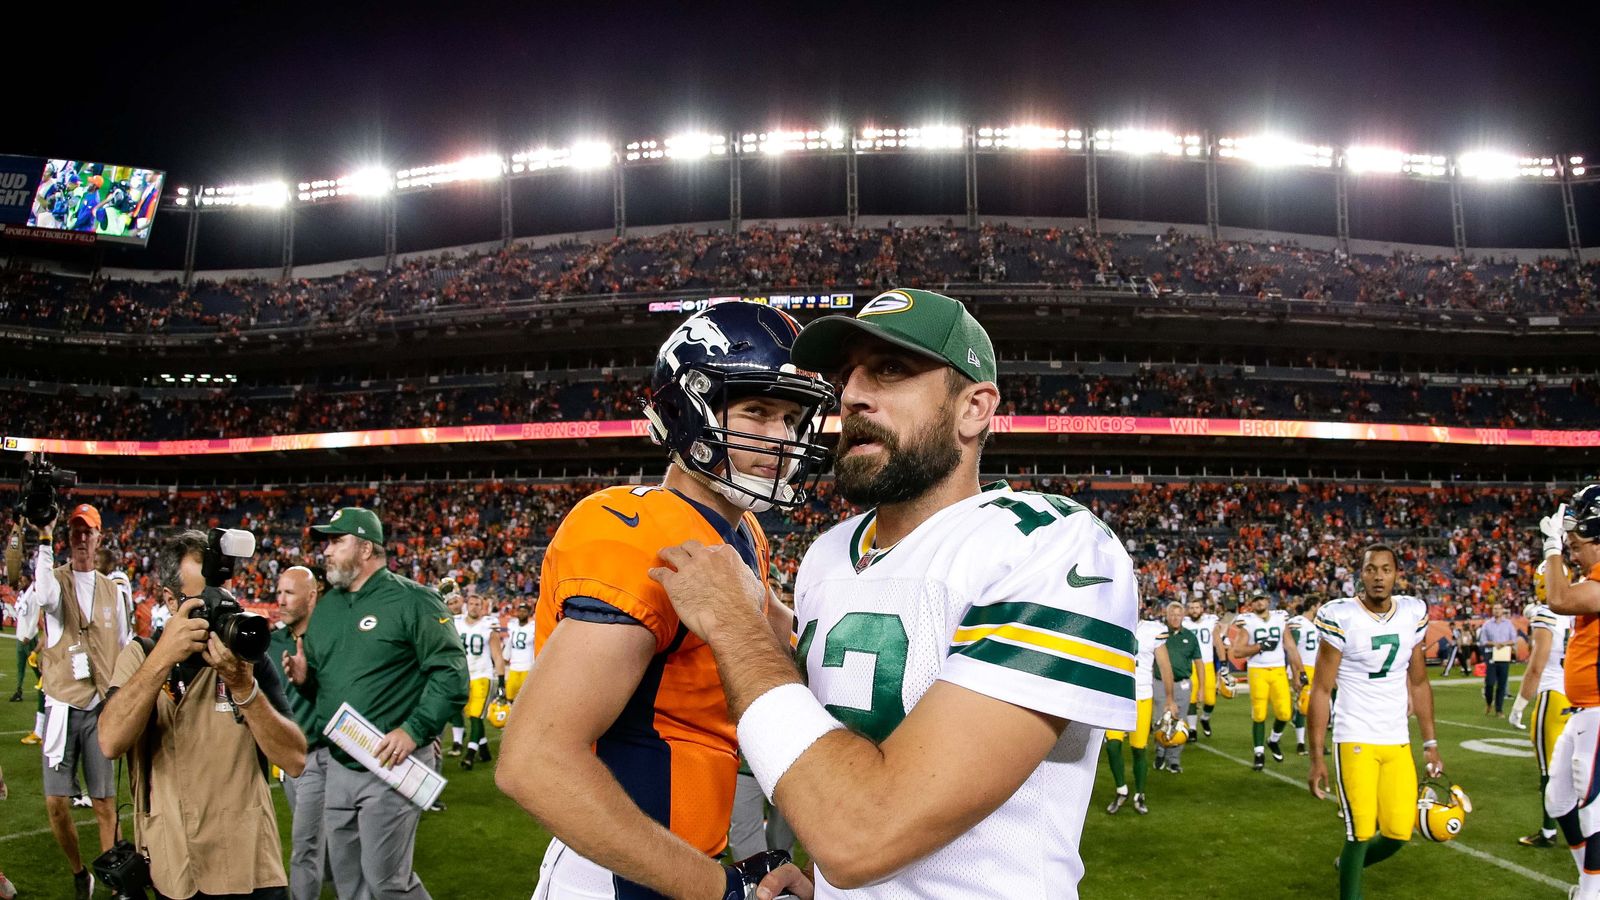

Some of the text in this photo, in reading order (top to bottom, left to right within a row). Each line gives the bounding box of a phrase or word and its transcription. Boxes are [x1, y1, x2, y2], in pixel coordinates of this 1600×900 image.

[5, 226, 96, 242] SPORTS AUTHORITY FIELD
[464, 425, 496, 441] WIN
[521, 421, 600, 438] BRONCOS
[1046, 416, 1136, 432] BRONCOS
[1169, 417, 1209, 433] WIN
[1475, 429, 1508, 445] WIN
[1368, 633, 1400, 680] 7
